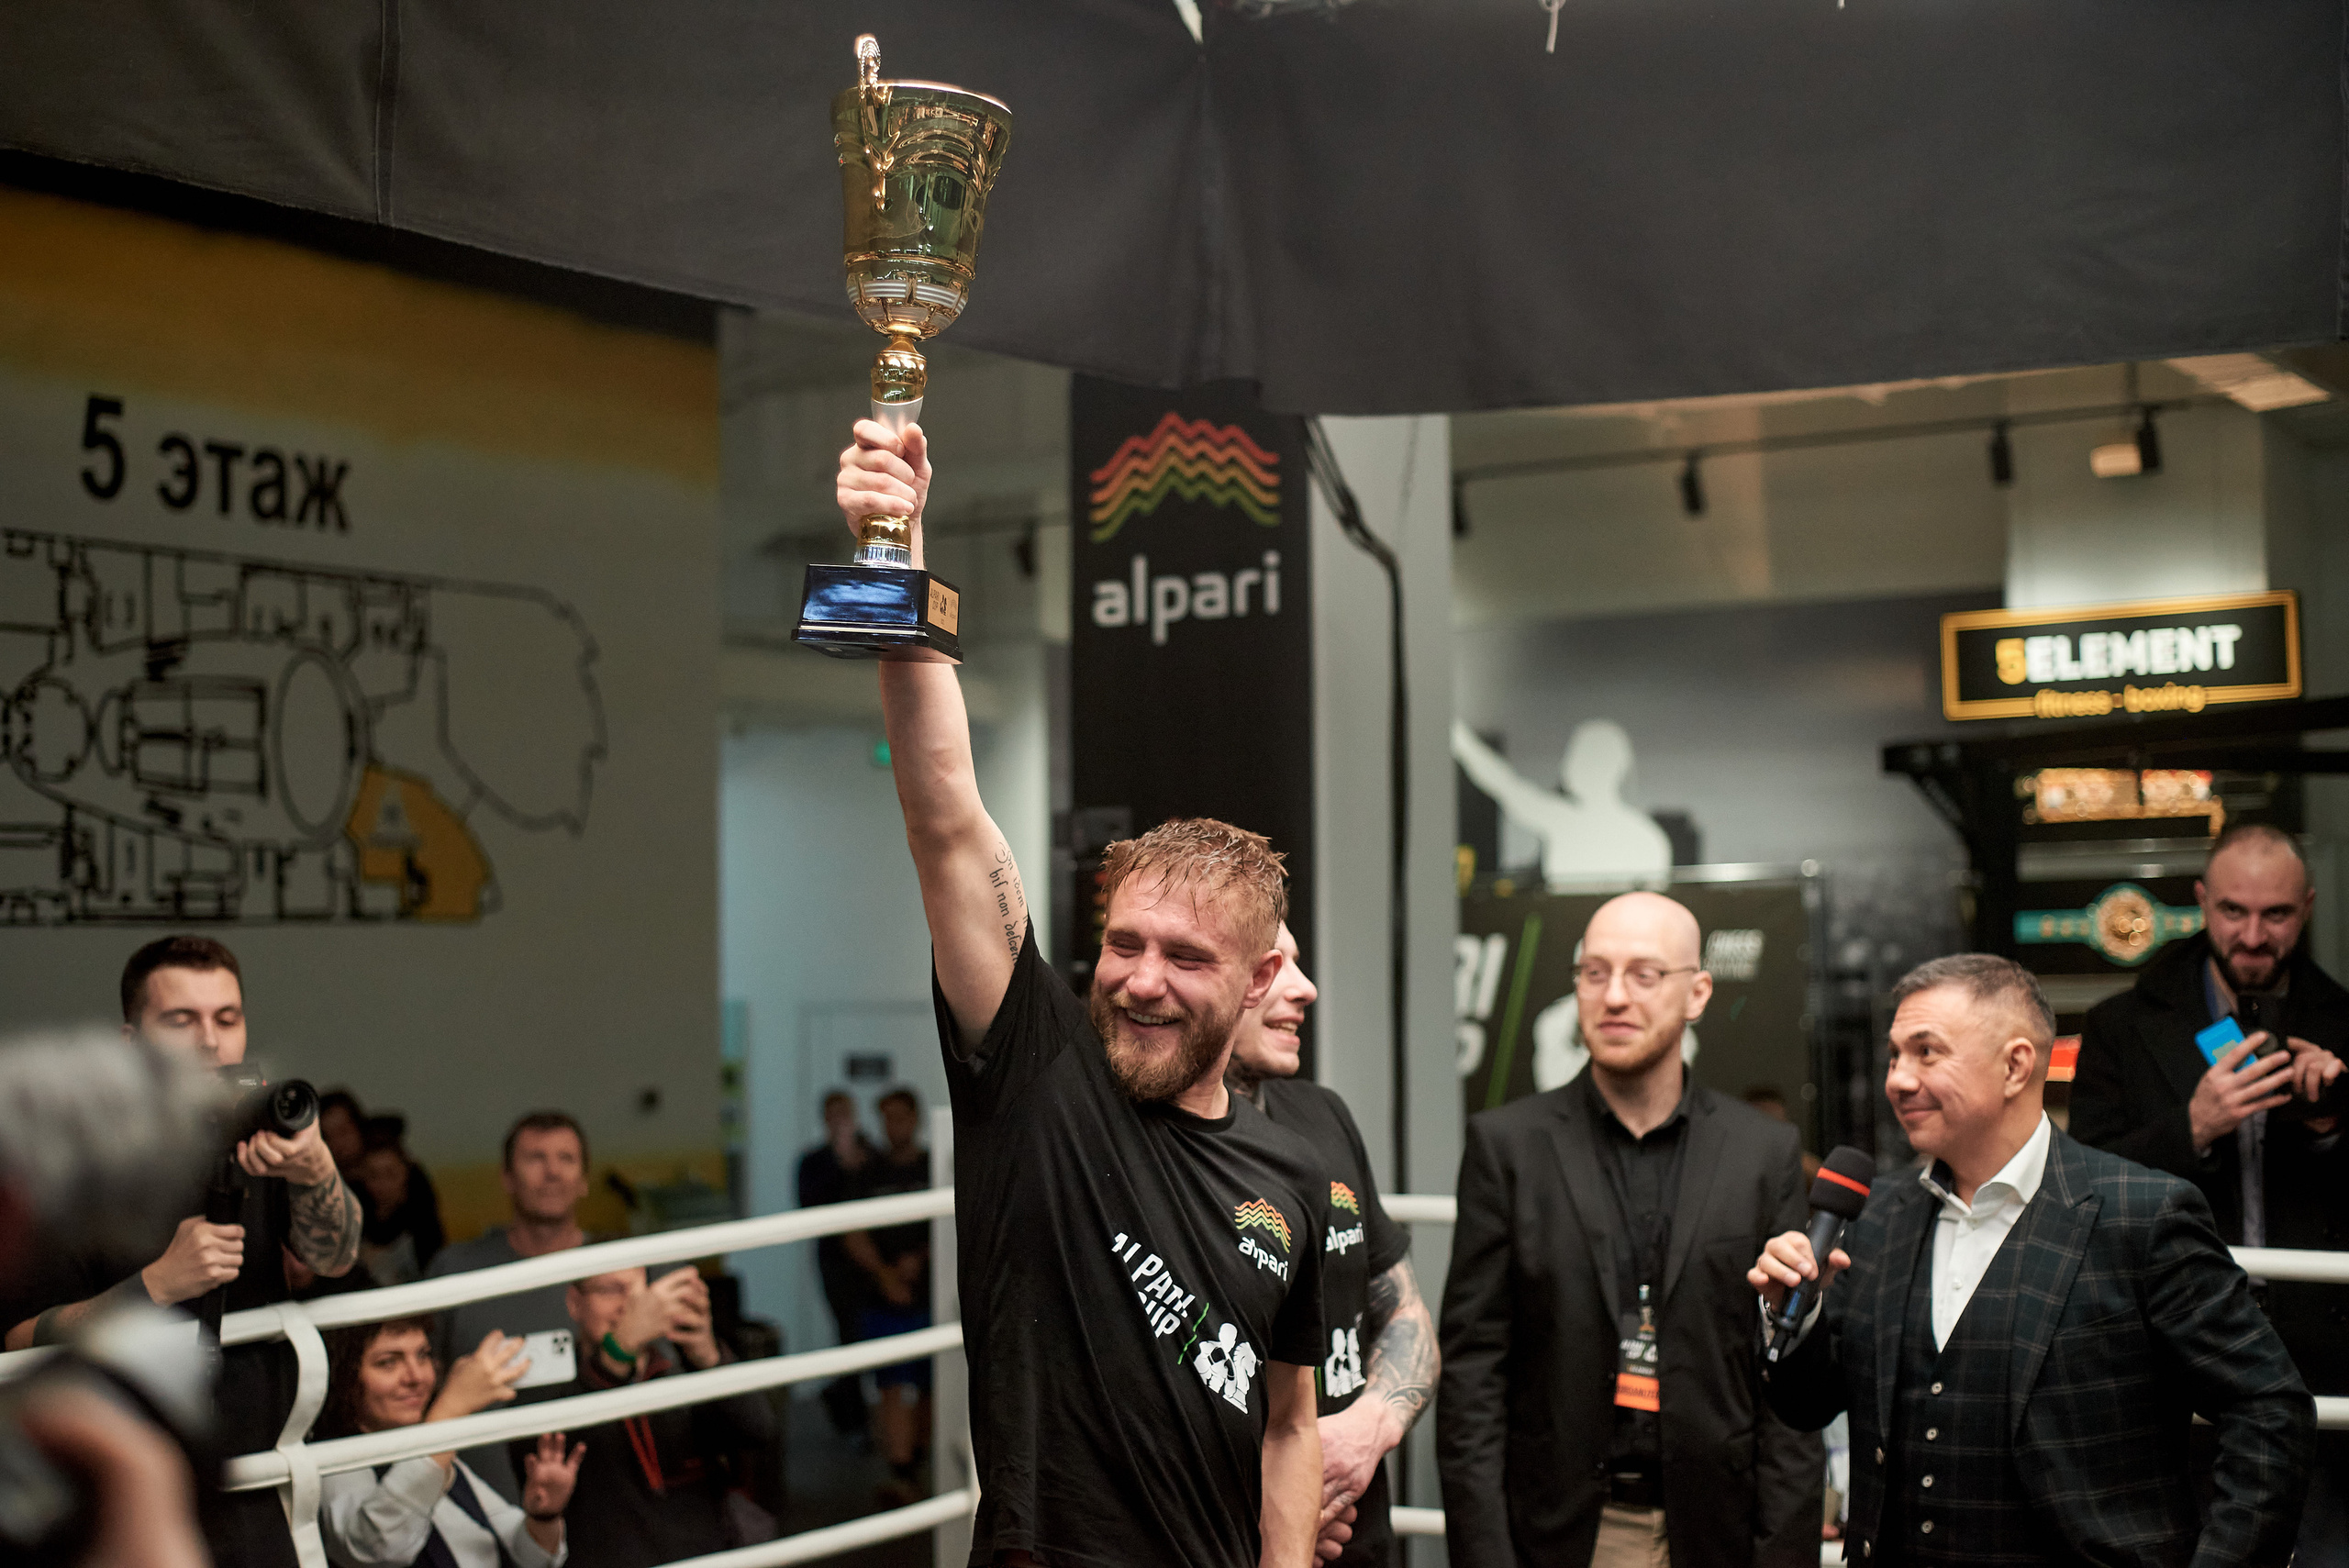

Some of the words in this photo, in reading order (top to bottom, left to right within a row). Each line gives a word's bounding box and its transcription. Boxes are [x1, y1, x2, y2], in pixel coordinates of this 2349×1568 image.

[82, 395, 124, 500] 5
[157, 431, 351, 533] этаж
[1092, 550, 1282, 646] alpari
[996, 892, 1010, 917] non
[1239, 1236, 1290, 1282] alpari
[1325, 1221, 1364, 1255] alpari
